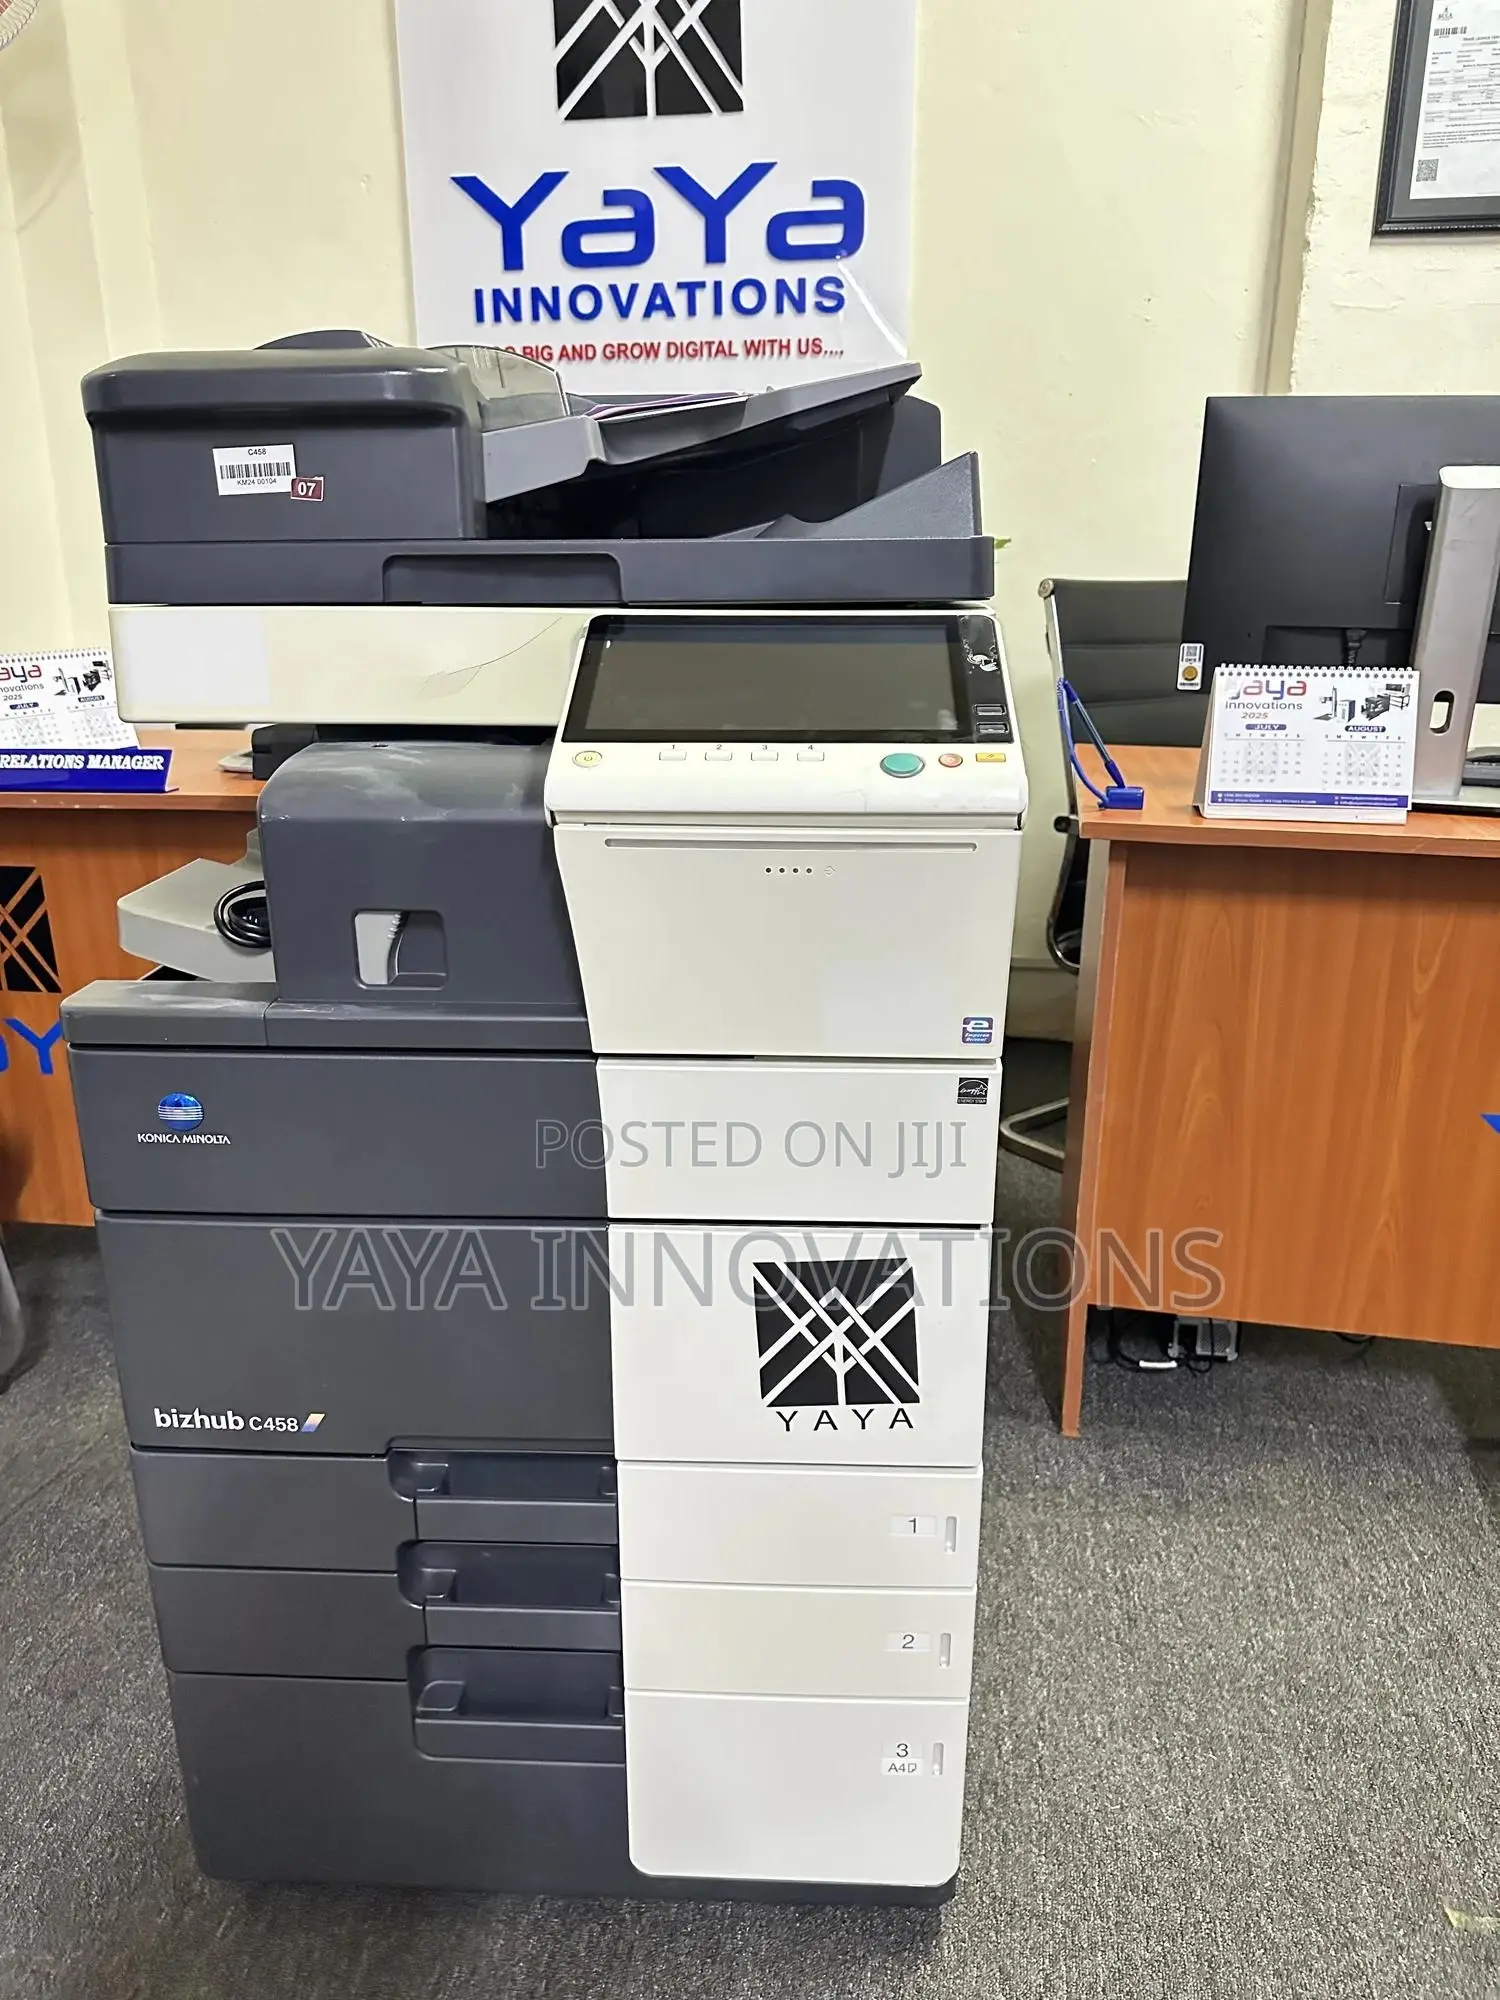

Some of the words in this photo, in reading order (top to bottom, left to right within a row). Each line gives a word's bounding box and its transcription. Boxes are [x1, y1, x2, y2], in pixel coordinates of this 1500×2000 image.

[449, 161, 865, 271] YaYa
[474, 276, 846, 324] INNOVATIONS
[522, 345, 554, 361] BIG
[558, 343, 597, 362] AND
[603, 341, 661, 361] GROW
[666, 340, 738, 359] DIGITAL
[744, 338, 791, 358] WITH
[248, 448, 267, 456] C458
[298, 481, 317, 497] 07
[1241, 712, 1269, 720] 2025
[0, 754, 85, 770] RELATIONS
[86, 754, 164, 770] MANAGER
[137, 1133, 181, 1144] KONICA
[182, 1134, 231, 1145] MINOLTA
[154, 1407, 245, 1430] bizhub
[249, 1416, 299, 1432] C458
[775, 1407, 914, 1432] YAYA
[907, 1517, 917, 1534] 1
[902, 1634, 915, 1649] 2
[896, 1743, 909, 1758] 3
[888, 1762, 905, 1773] A4
